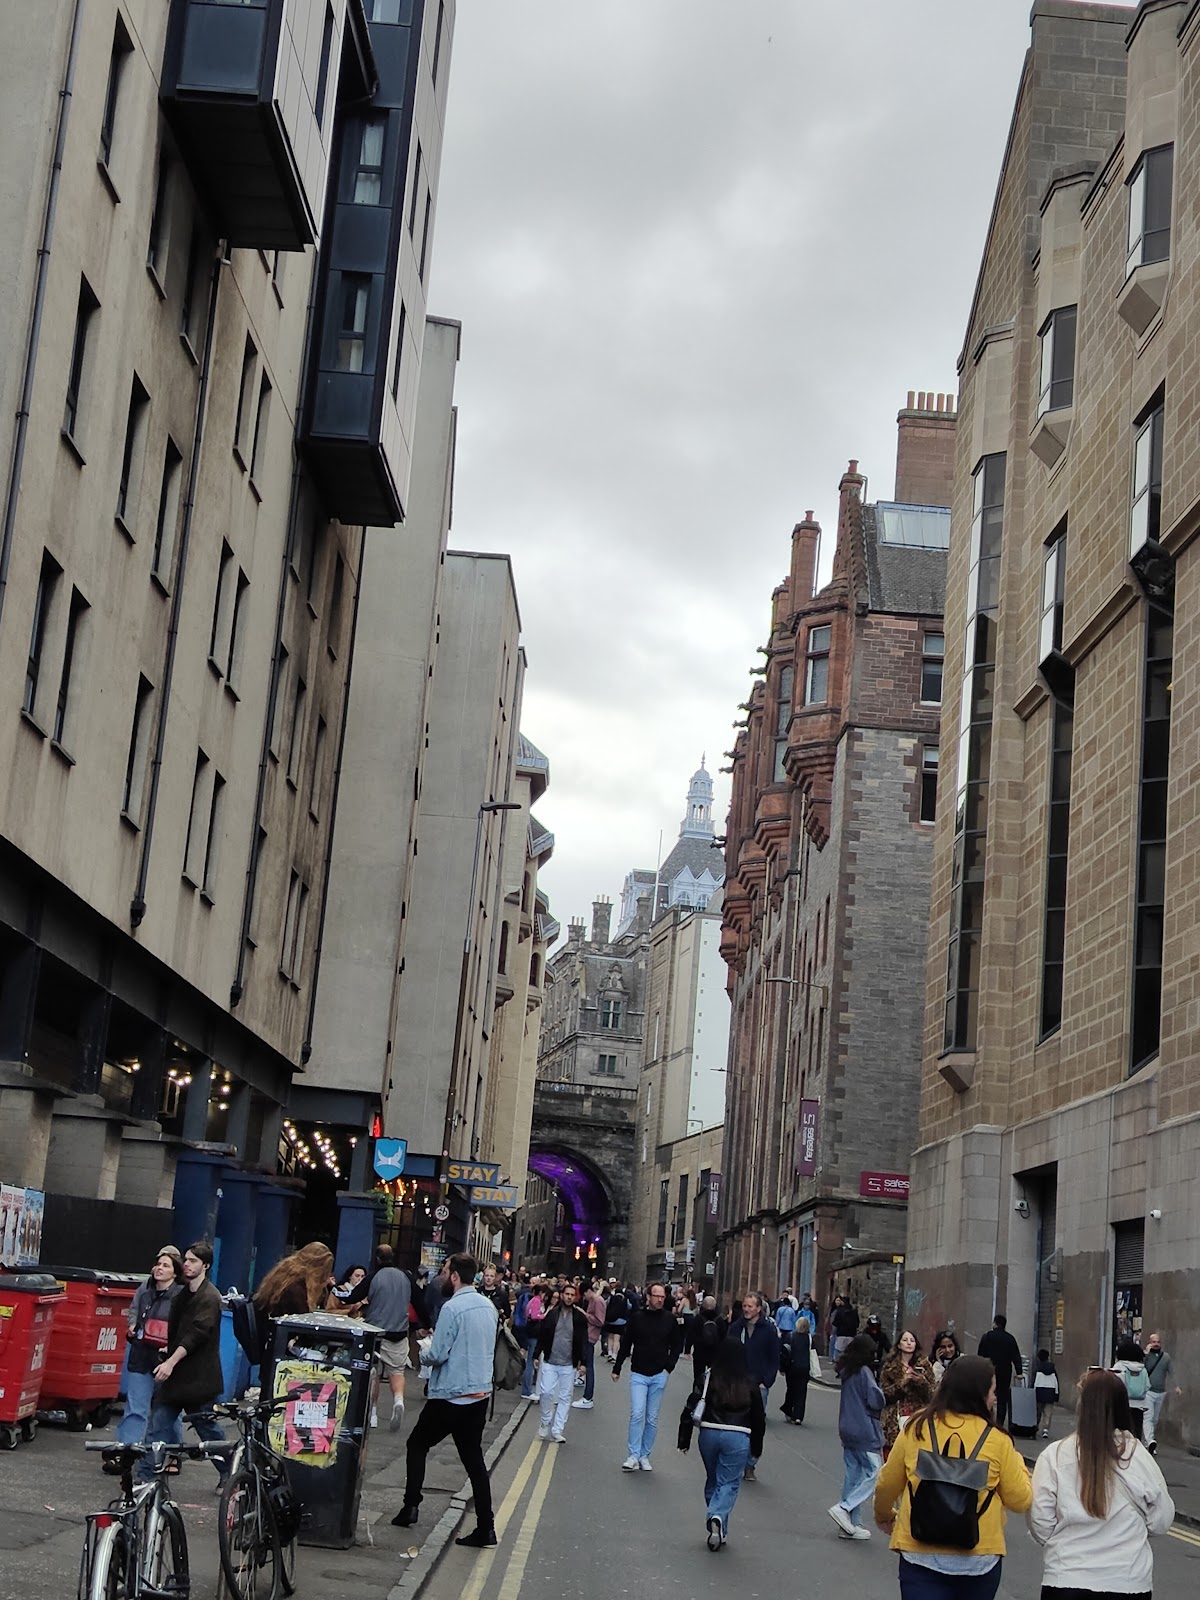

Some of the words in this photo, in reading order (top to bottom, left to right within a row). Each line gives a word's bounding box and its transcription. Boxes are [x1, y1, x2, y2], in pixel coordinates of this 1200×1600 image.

[448, 1164, 496, 1182] STAY
[883, 1178, 910, 1189] safes
[473, 1187, 513, 1203] STAY
